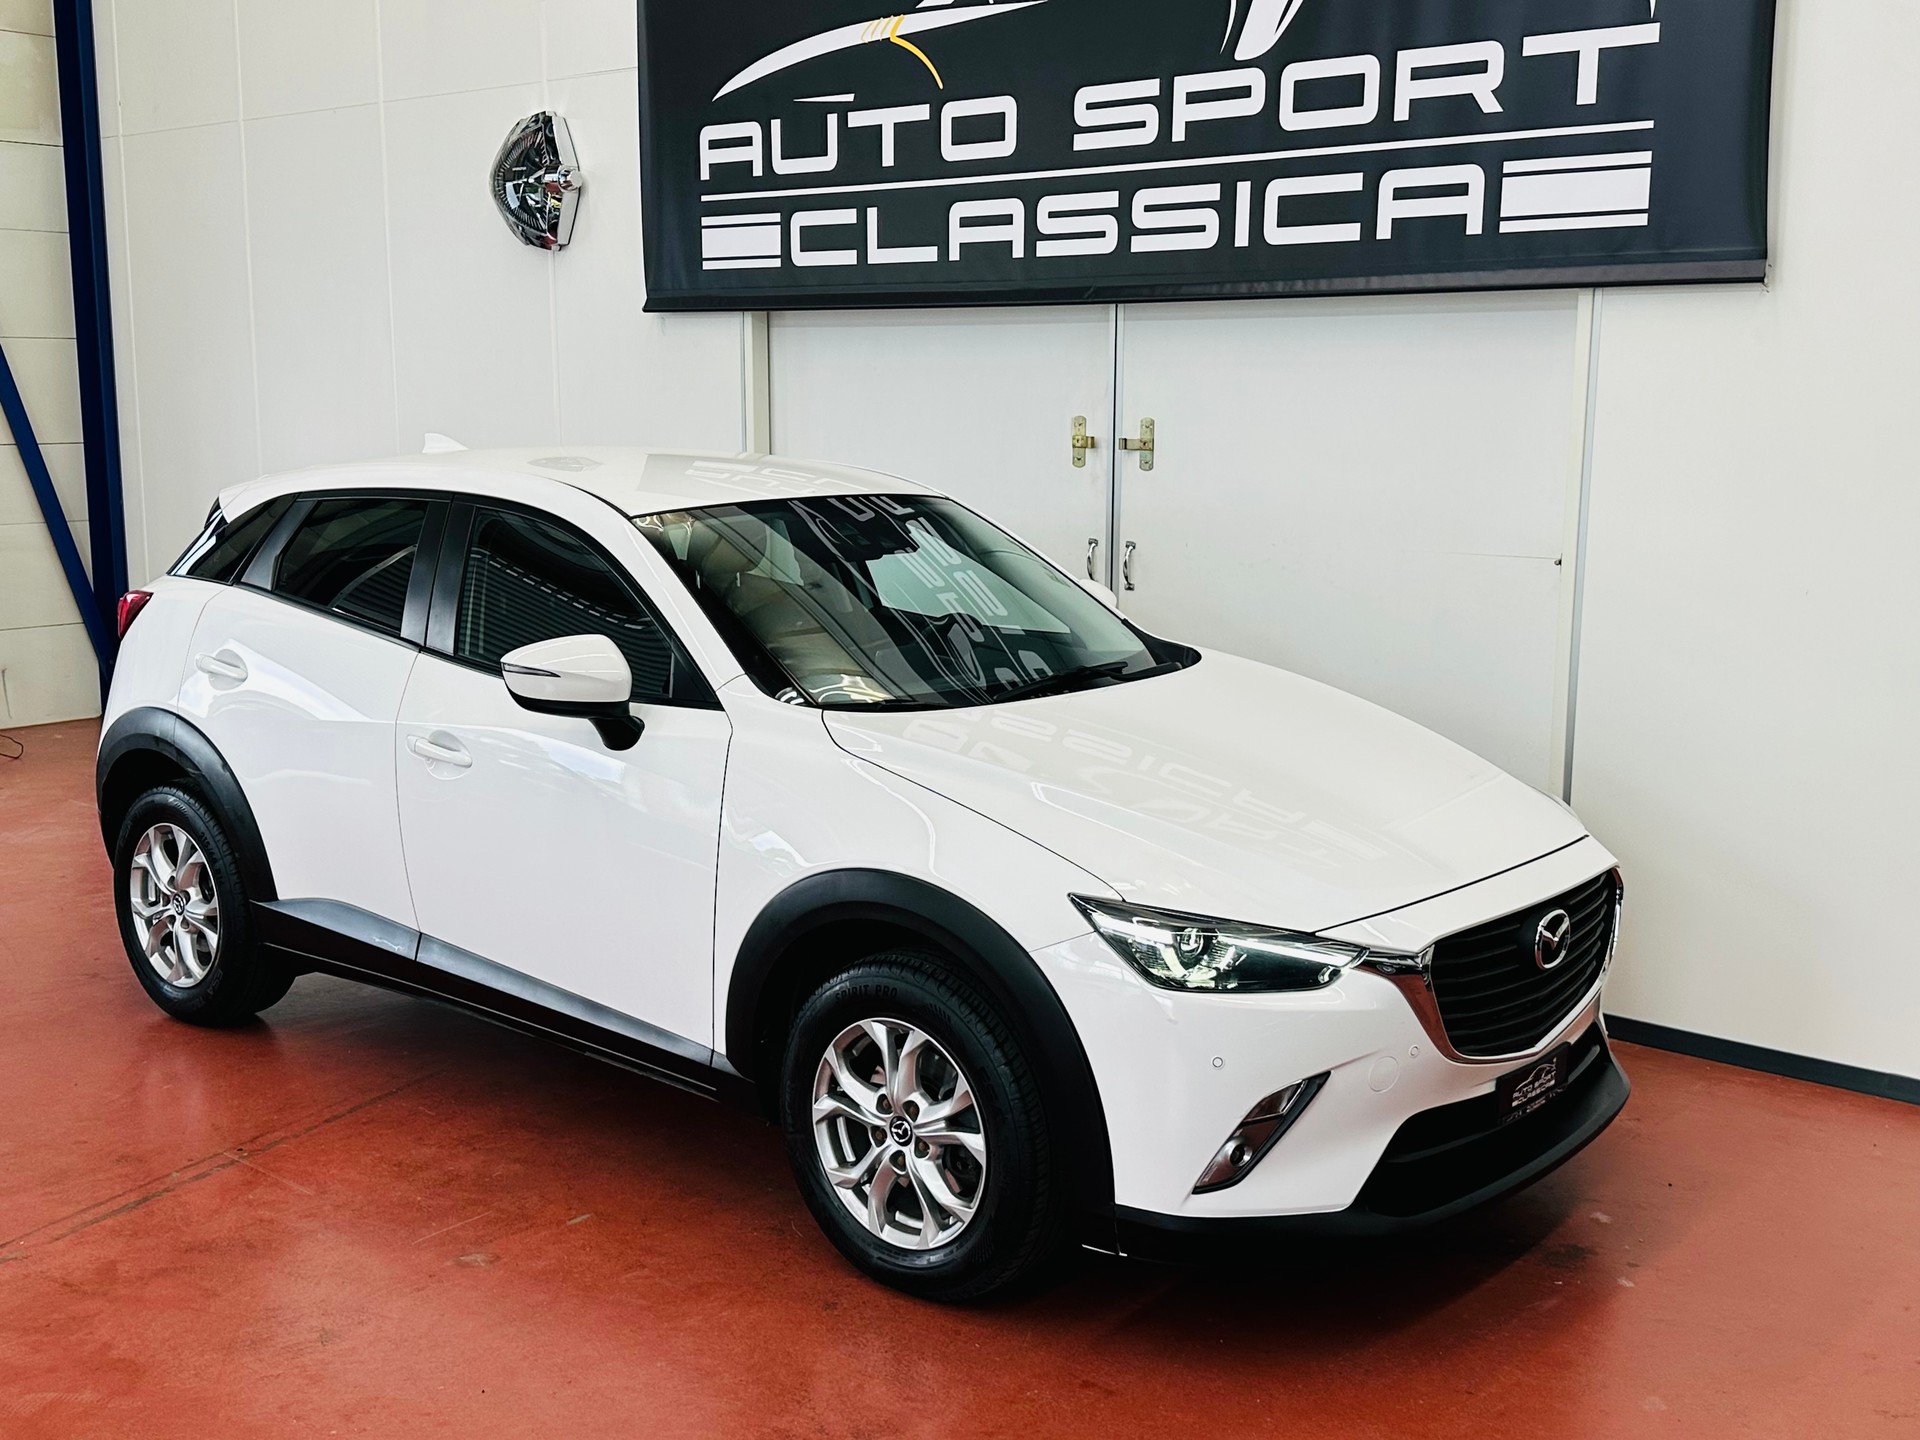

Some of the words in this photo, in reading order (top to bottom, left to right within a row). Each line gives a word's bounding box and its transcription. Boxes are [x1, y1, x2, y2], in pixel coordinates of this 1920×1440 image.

[699, 95, 1018, 181] AUTO
[1073, 22, 1661, 151] SPORT
[790, 163, 1485, 267] CLASSICA
[835, 984, 870, 1004] SPIRIT
[875, 984, 898, 1001] PRO
[1512, 1083, 1534, 1099] AUTO
